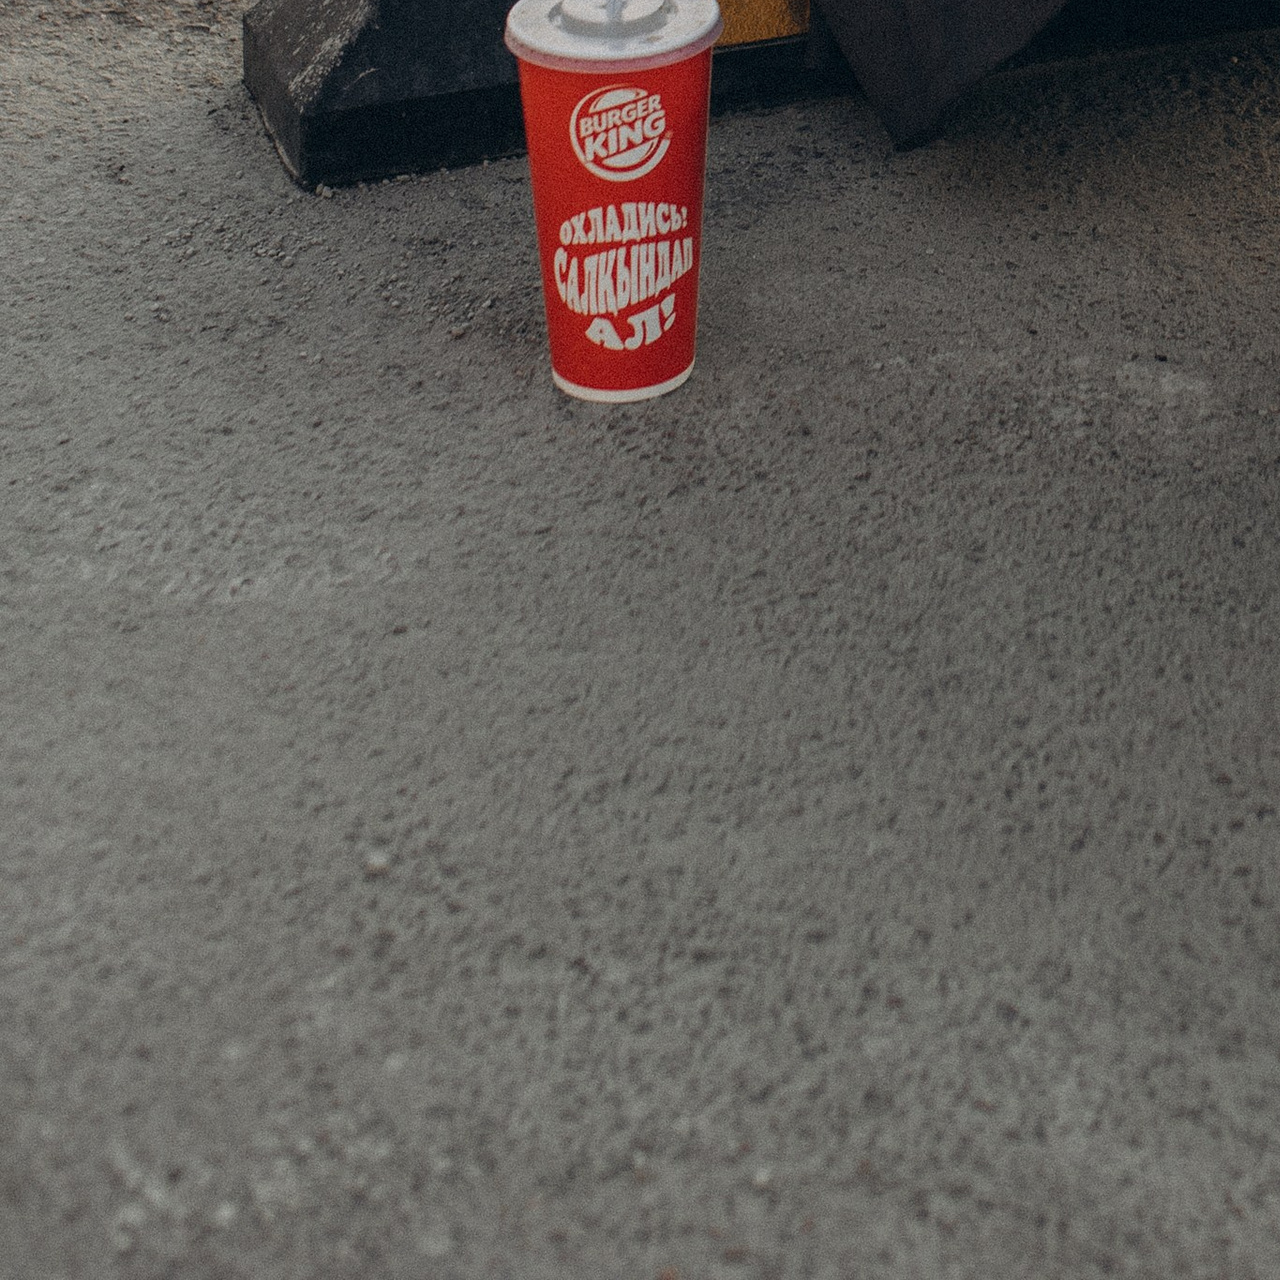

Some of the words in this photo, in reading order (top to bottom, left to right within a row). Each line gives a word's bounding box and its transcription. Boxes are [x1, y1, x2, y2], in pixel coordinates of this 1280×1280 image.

[580, 94, 661, 138] BURGER
[584, 110, 666, 161] KING
[559, 202, 688, 246] ОХЛАДИСЬ!
[585, 293, 676, 351] АЛ!
